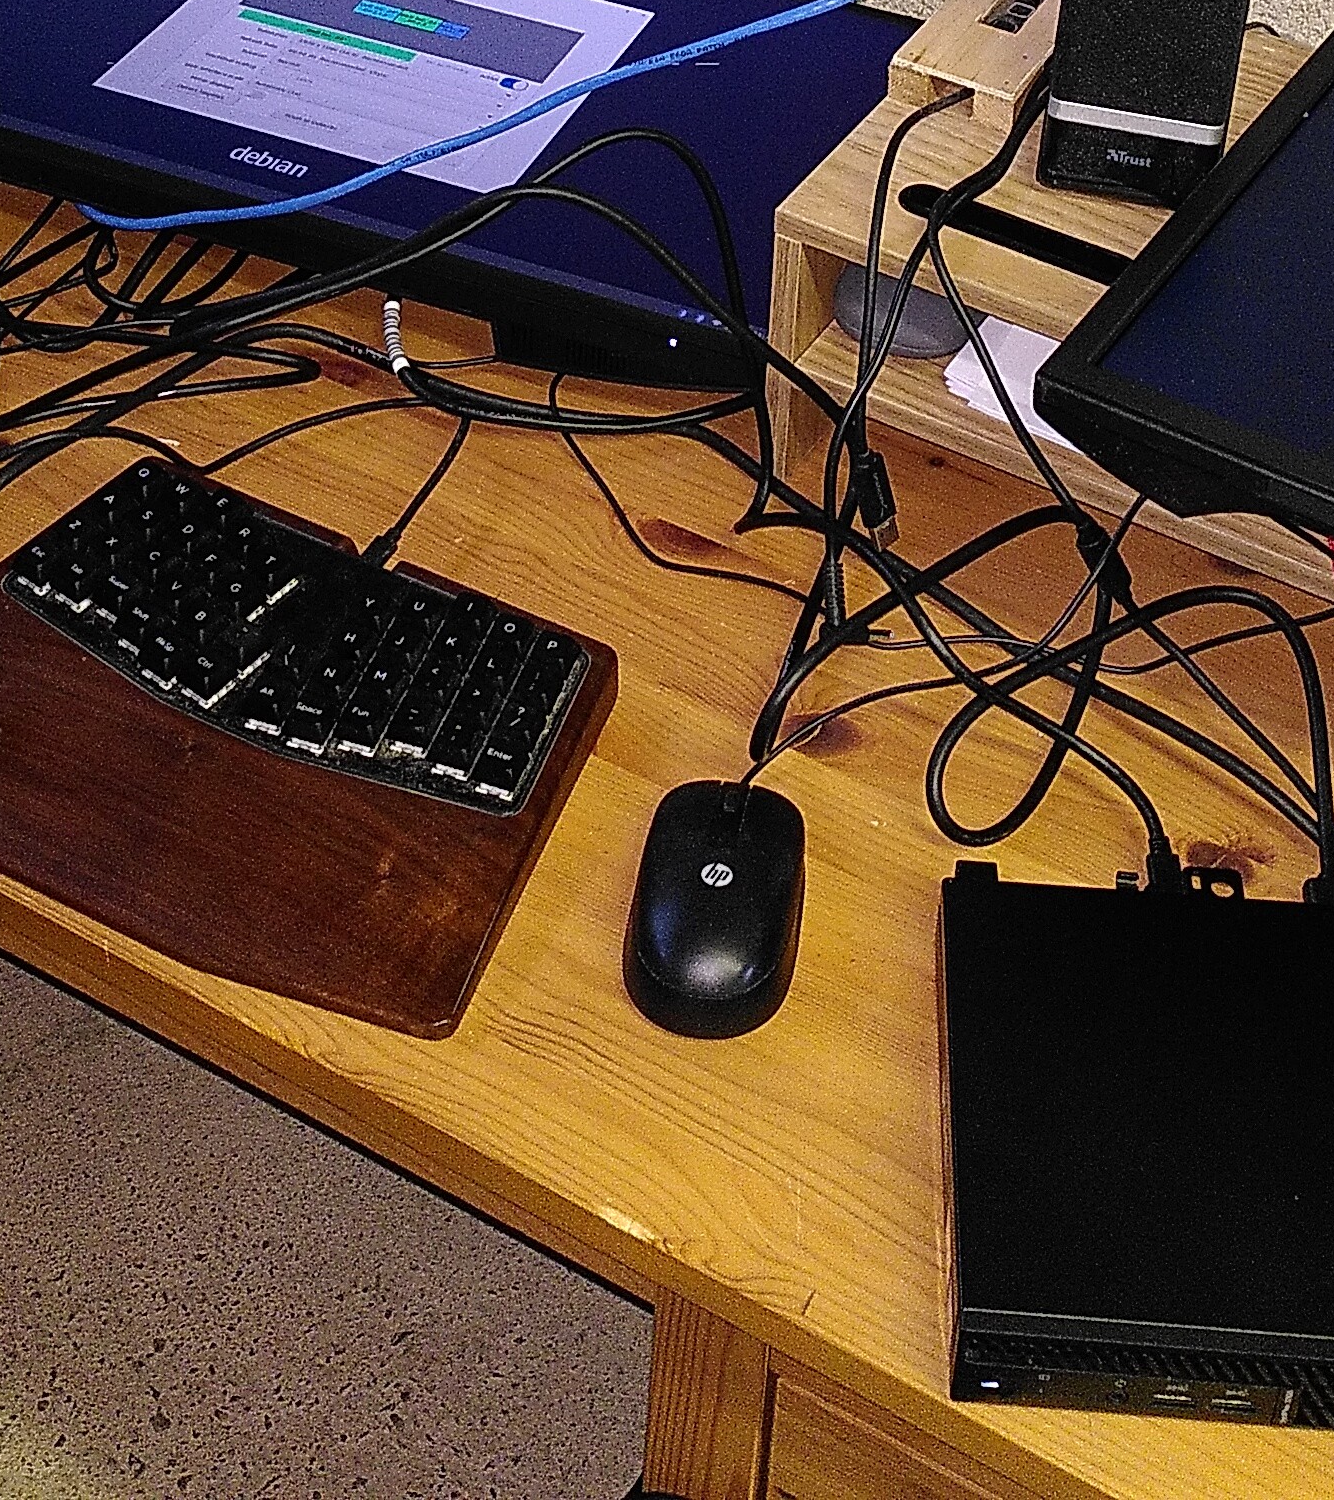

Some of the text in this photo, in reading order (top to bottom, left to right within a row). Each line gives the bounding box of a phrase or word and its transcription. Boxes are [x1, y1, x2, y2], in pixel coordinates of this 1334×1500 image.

[229, 146, 309, 178] debian
[1117, 149, 1152, 168] Trust
[486, 747, 513, 761] Enter
[700, 862, 734, 888] hp
